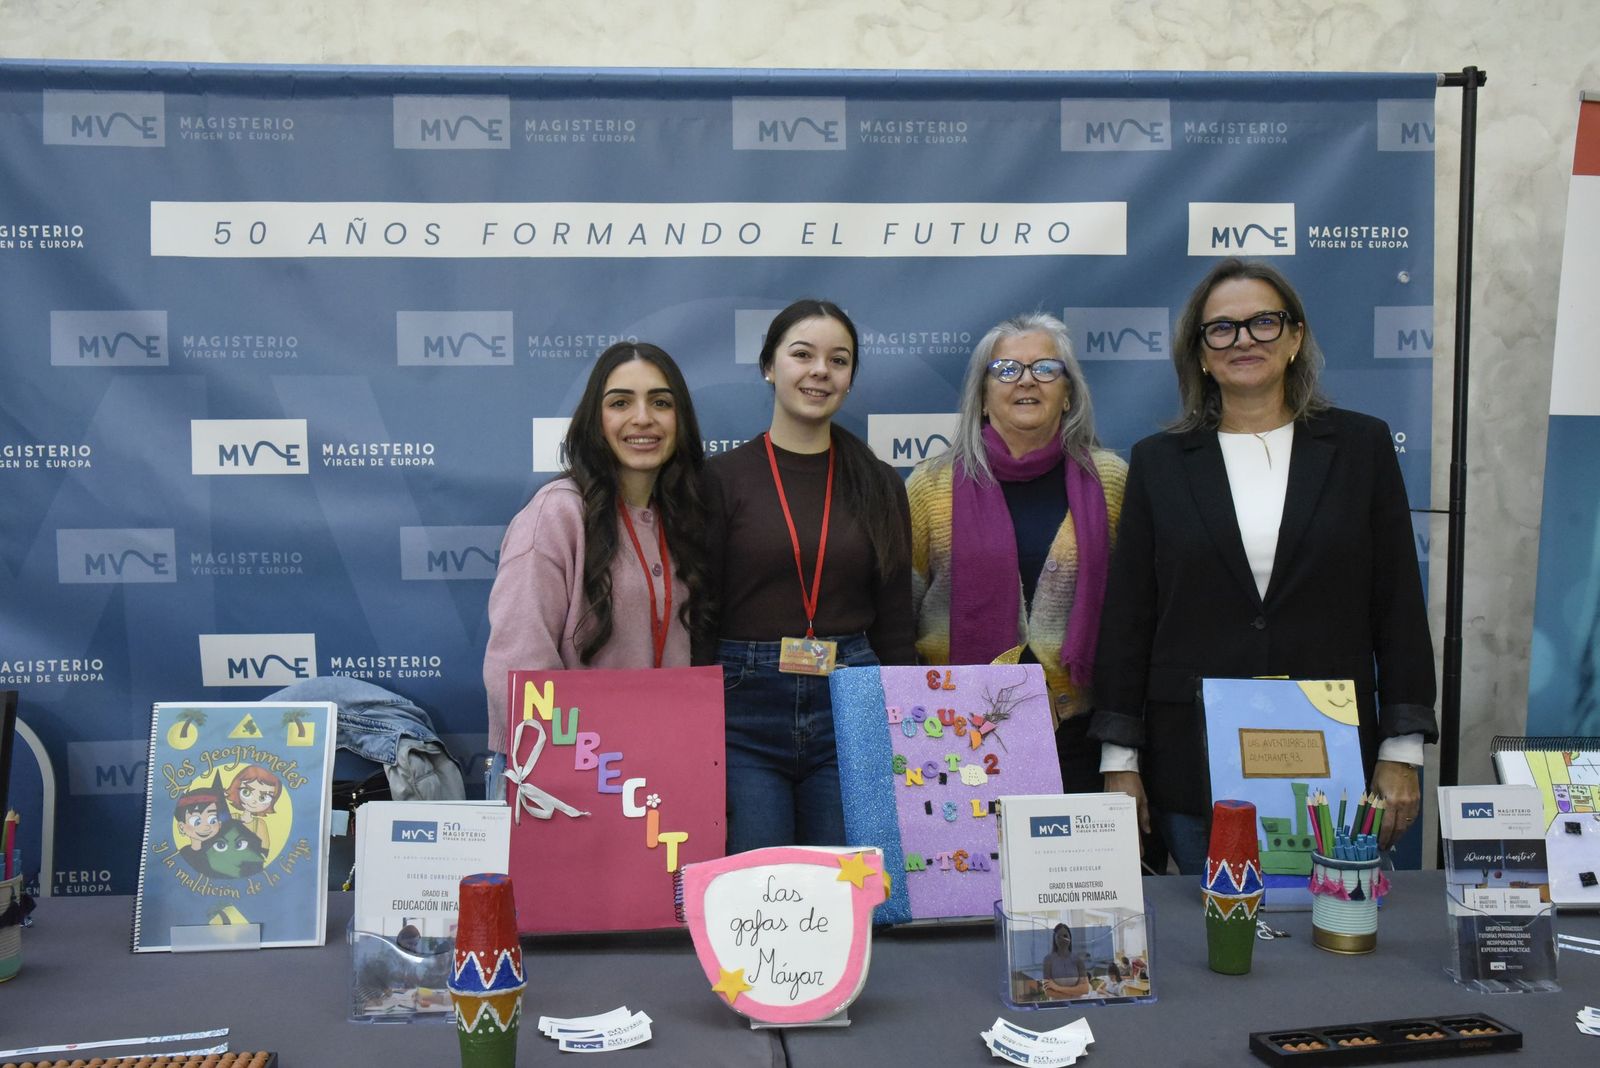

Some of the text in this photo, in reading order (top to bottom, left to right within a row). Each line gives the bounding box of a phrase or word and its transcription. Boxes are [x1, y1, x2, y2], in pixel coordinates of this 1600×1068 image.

[71, 113, 157, 139] MVE
[180, 116, 294, 131] MAGISTERIO
[421, 115, 503, 142] MVE
[525, 120, 636, 132] MAGISTERIO
[758, 117, 839, 143] MVE
[860, 121, 968, 133] MAGISTERIO
[1184, 122, 1288, 134] MAGISTERIO
[181, 130, 294, 141] VIRGEN DE EUROPA
[525, 133, 636, 142] VIRGEN DE EUROPA
[1086, 119, 1164, 144] MVE
[1401, 122, 1435, 144] MV
[861, 134, 968, 144] VIRGEN DE EUROPA
[1185, 135, 1288, 144] VIRGEN DE EUROPA
[0, 225, 84, 237] GISTERIO
[215, 217, 1071, 245] 50 AÑOS FORMANDO EL FUTURO
[1211, 223, 1288, 249] MVE
[1309, 226, 1409, 239] MAGISTERIO
[40, 240, 84, 248] EUROPA
[1309, 239, 1409, 249] VIRGEN DE EUROPA
[183, 335, 298, 348] MAGISTERIO
[863, 332, 971, 344] MAGISTERIO
[1087, 328, 1162, 353] MVE
[1398, 329, 1434, 352] MV
[78, 332, 161, 358] MVE
[424, 332, 506, 358] MVE
[863, 345, 971, 355] VIRGEN DE EUROPA
[183, 349, 298, 359] VIRGEN DE EUROPA
[529, 349, 570, 358] VIRGEN
[576, 350, 589, 358] DE
[3, 445, 91, 457] GISTERIO
[218, 440, 300, 466] MVE
[322, 443, 435, 456] MAGISTERIO
[893, 434, 952, 459] MV
[0, 459, 91, 468] GEN DE EUROPA
[323, 457, 435, 467] VIRGEN DE EUROPA
[85, 549, 168, 576] MVE
[191, 552, 303, 564] MAGISTERIO
[427, 546, 500, 572] MV
[191, 565, 303, 575] VIRGEN DE EUROPA
[0, 659, 104, 673] AGISTERIO
[228, 654, 310, 679] MVE
[331, 656, 441, 669] MAGISTERIO
[0, 673, 104, 684] RGEN DE EUROPA
[379, 670, 391, 678] DE
[398, 670, 441, 678] EUROPA
[96, 761, 148, 788] MV
[56, 870, 111, 883] TERIO
[66, 884, 112, 894] EUROPA
[246, 878, 262, 895] de
[763, 875, 803, 902] Las
[1049, 882, 1066, 890] GRADO
[422, 890, 449, 898] GRADO EN
[1038, 890, 1118, 904] EDUCACIÓN PRIMARIA
[392, 899, 460, 911] EDUCACIÓN INFA
[730, 907, 829, 946] gafas de
[748, 948, 825, 1000] Máyar
